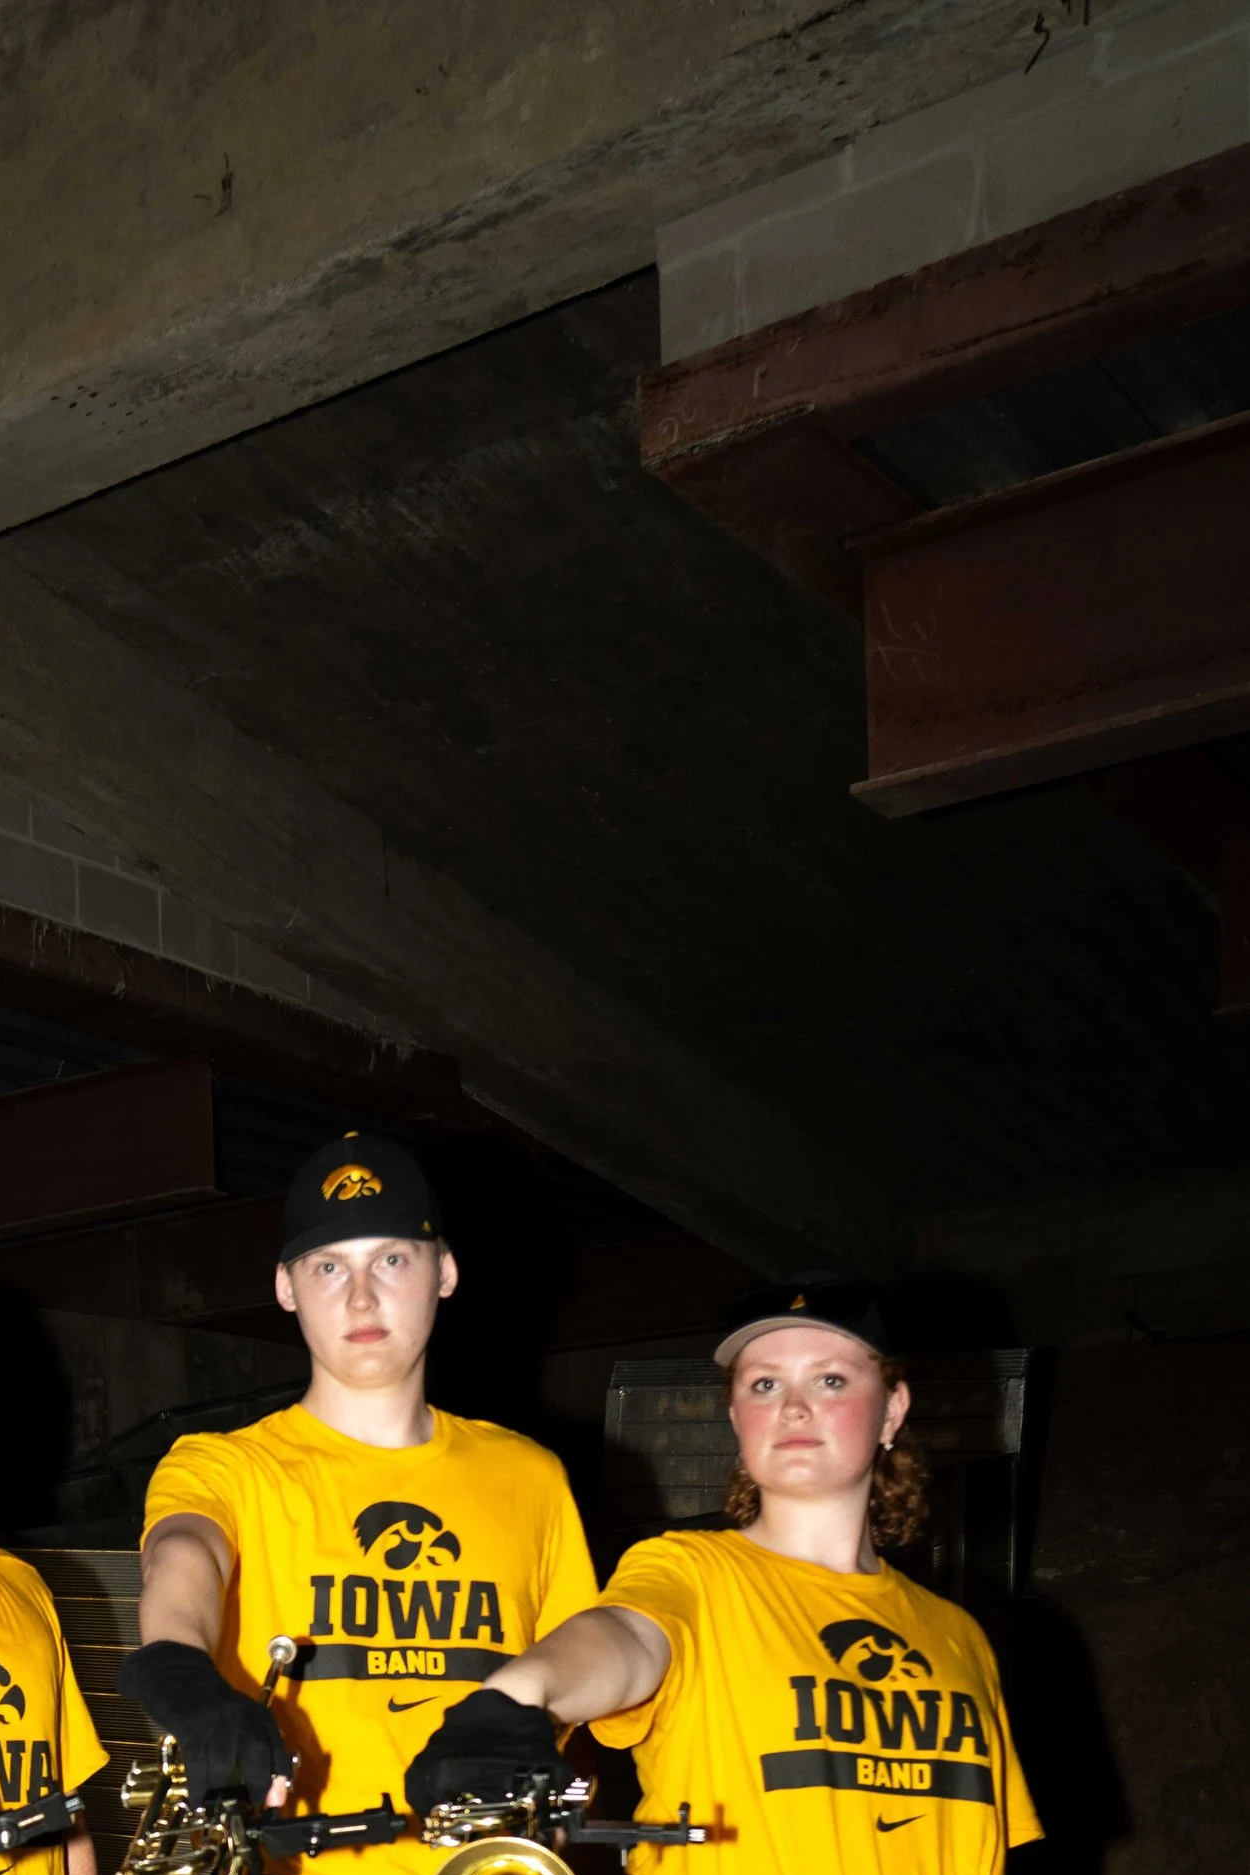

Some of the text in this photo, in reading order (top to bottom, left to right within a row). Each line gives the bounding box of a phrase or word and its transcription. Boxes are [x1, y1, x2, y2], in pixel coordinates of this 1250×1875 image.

[309, 1574, 505, 1644] IOWA
[367, 1651, 446, 1676] BAND
[789, 1675, 989, 1758] IOWA
[856, 1757, 932, 1791] BAND
